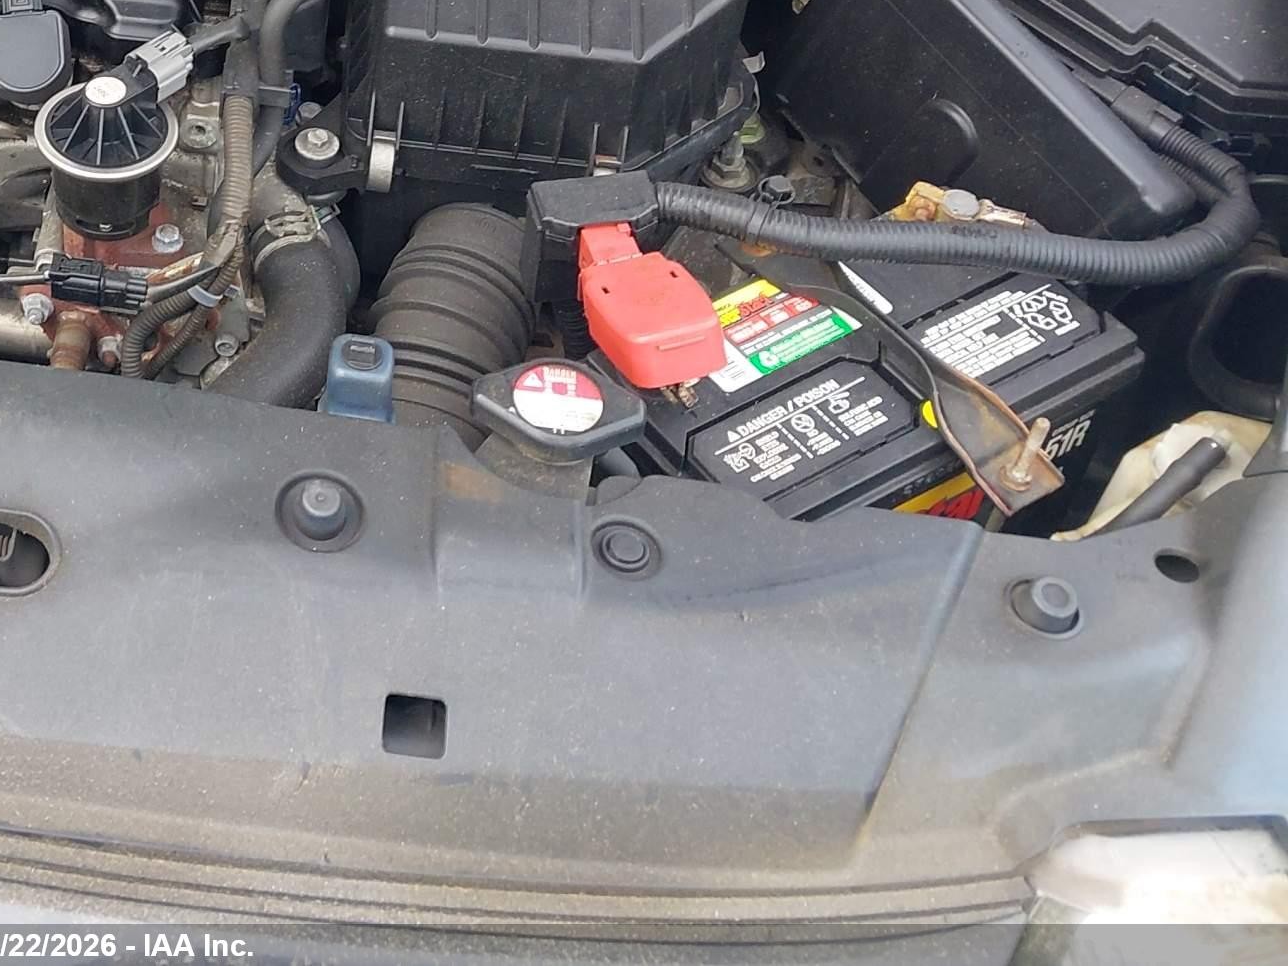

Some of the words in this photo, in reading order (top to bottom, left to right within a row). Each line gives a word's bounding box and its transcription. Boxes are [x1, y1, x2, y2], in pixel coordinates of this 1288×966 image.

[735, 405, 789, 436] DANGER
[794, 379, 841, 406] POISON
[1044, 419, 1092, 461] 51R
